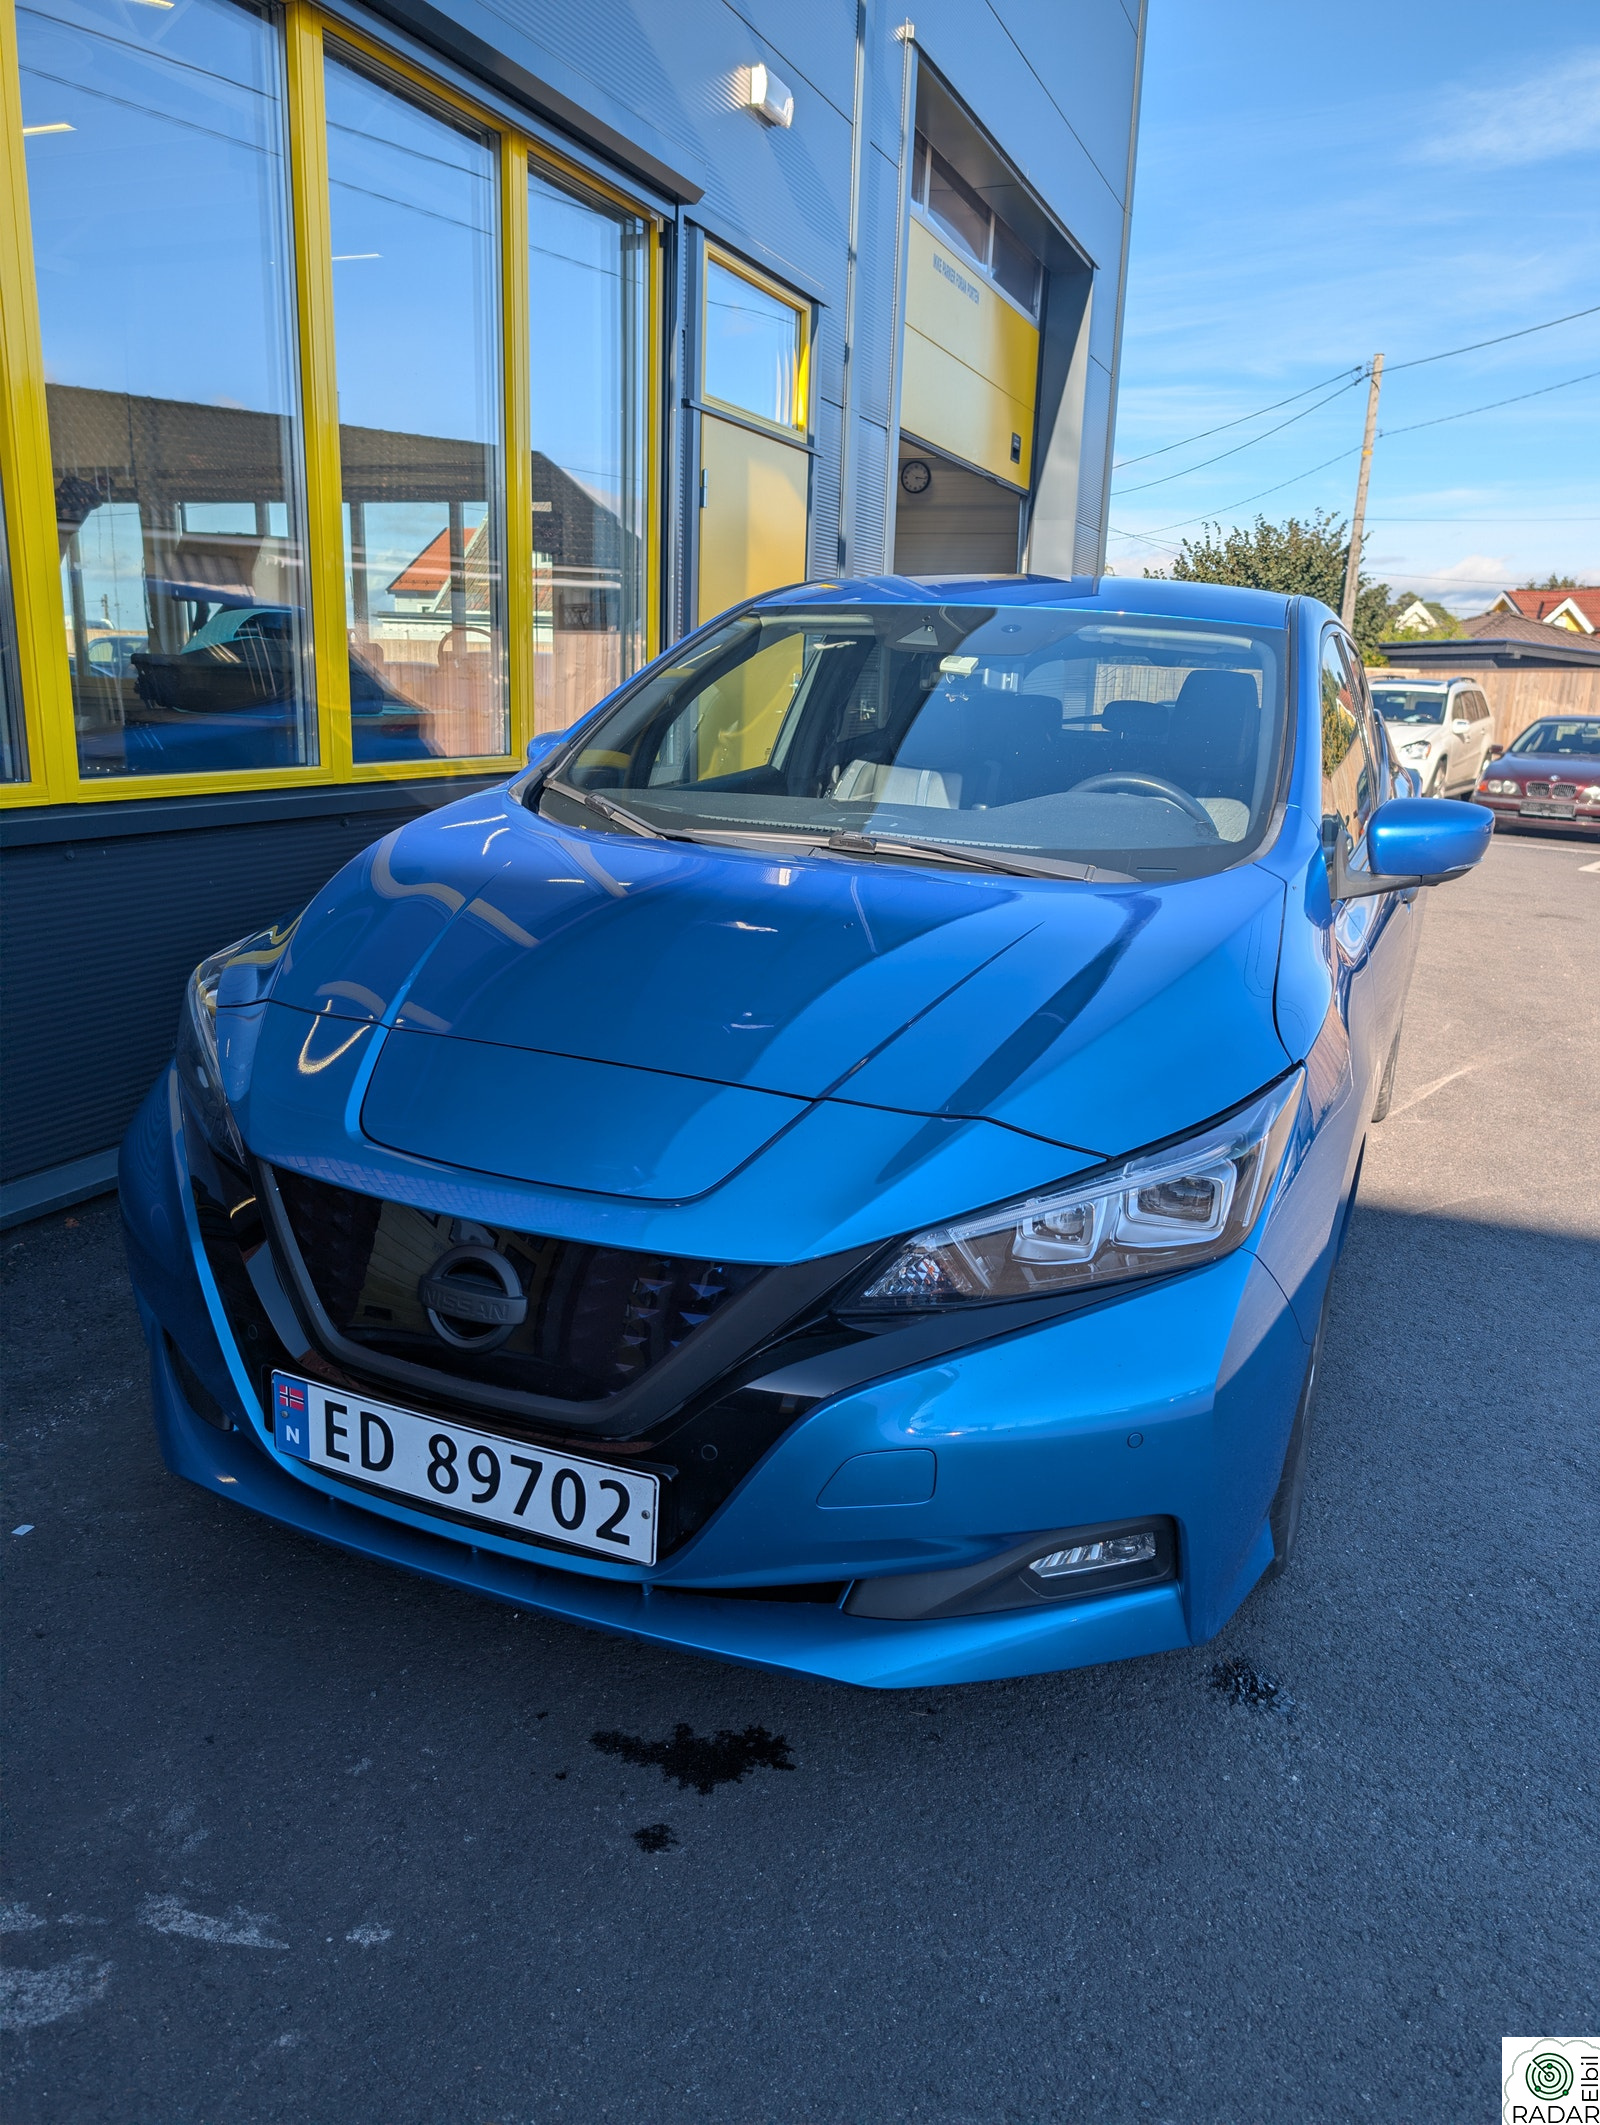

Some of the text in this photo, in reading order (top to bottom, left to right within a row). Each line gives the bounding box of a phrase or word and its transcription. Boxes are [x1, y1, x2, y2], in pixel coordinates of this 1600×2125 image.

[423, 1287, 510, 1321] NISSAN
[286, 1425, 300, 1445] N
[324, 1399, 631, 1546] ED 89702
